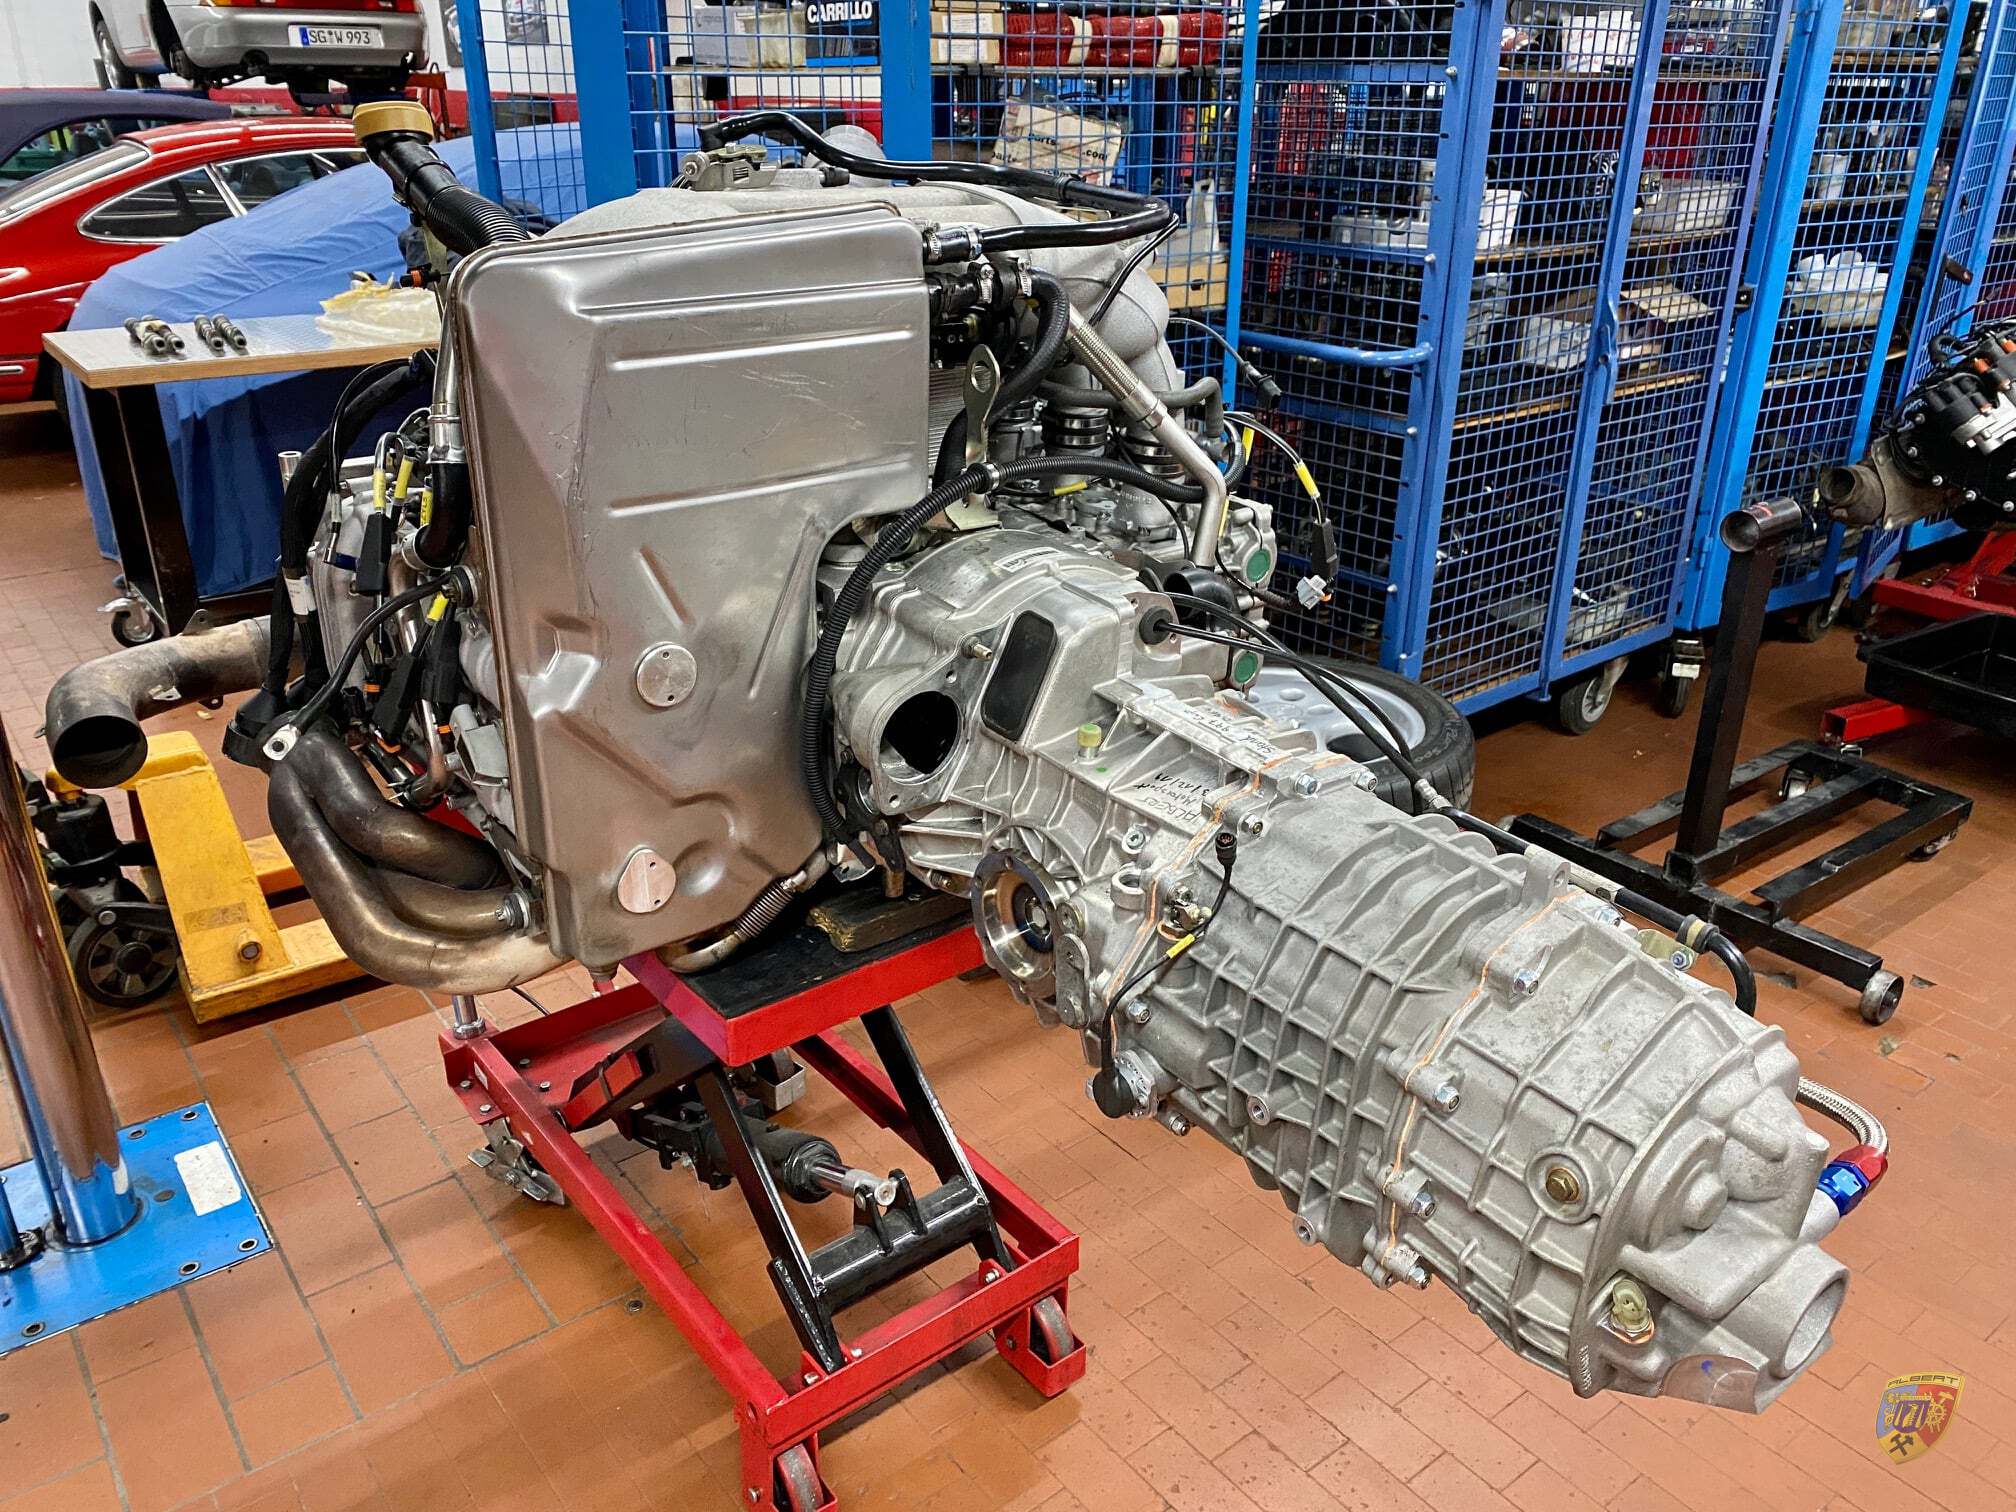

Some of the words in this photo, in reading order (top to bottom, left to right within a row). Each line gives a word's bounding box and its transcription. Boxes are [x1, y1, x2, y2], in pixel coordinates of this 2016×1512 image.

[807, 1, 872, 23] CARRILLO
[309, 30, 327, 43] SG
[334, 31, 342, 44] W
[346, 31, 371, 44] 993
